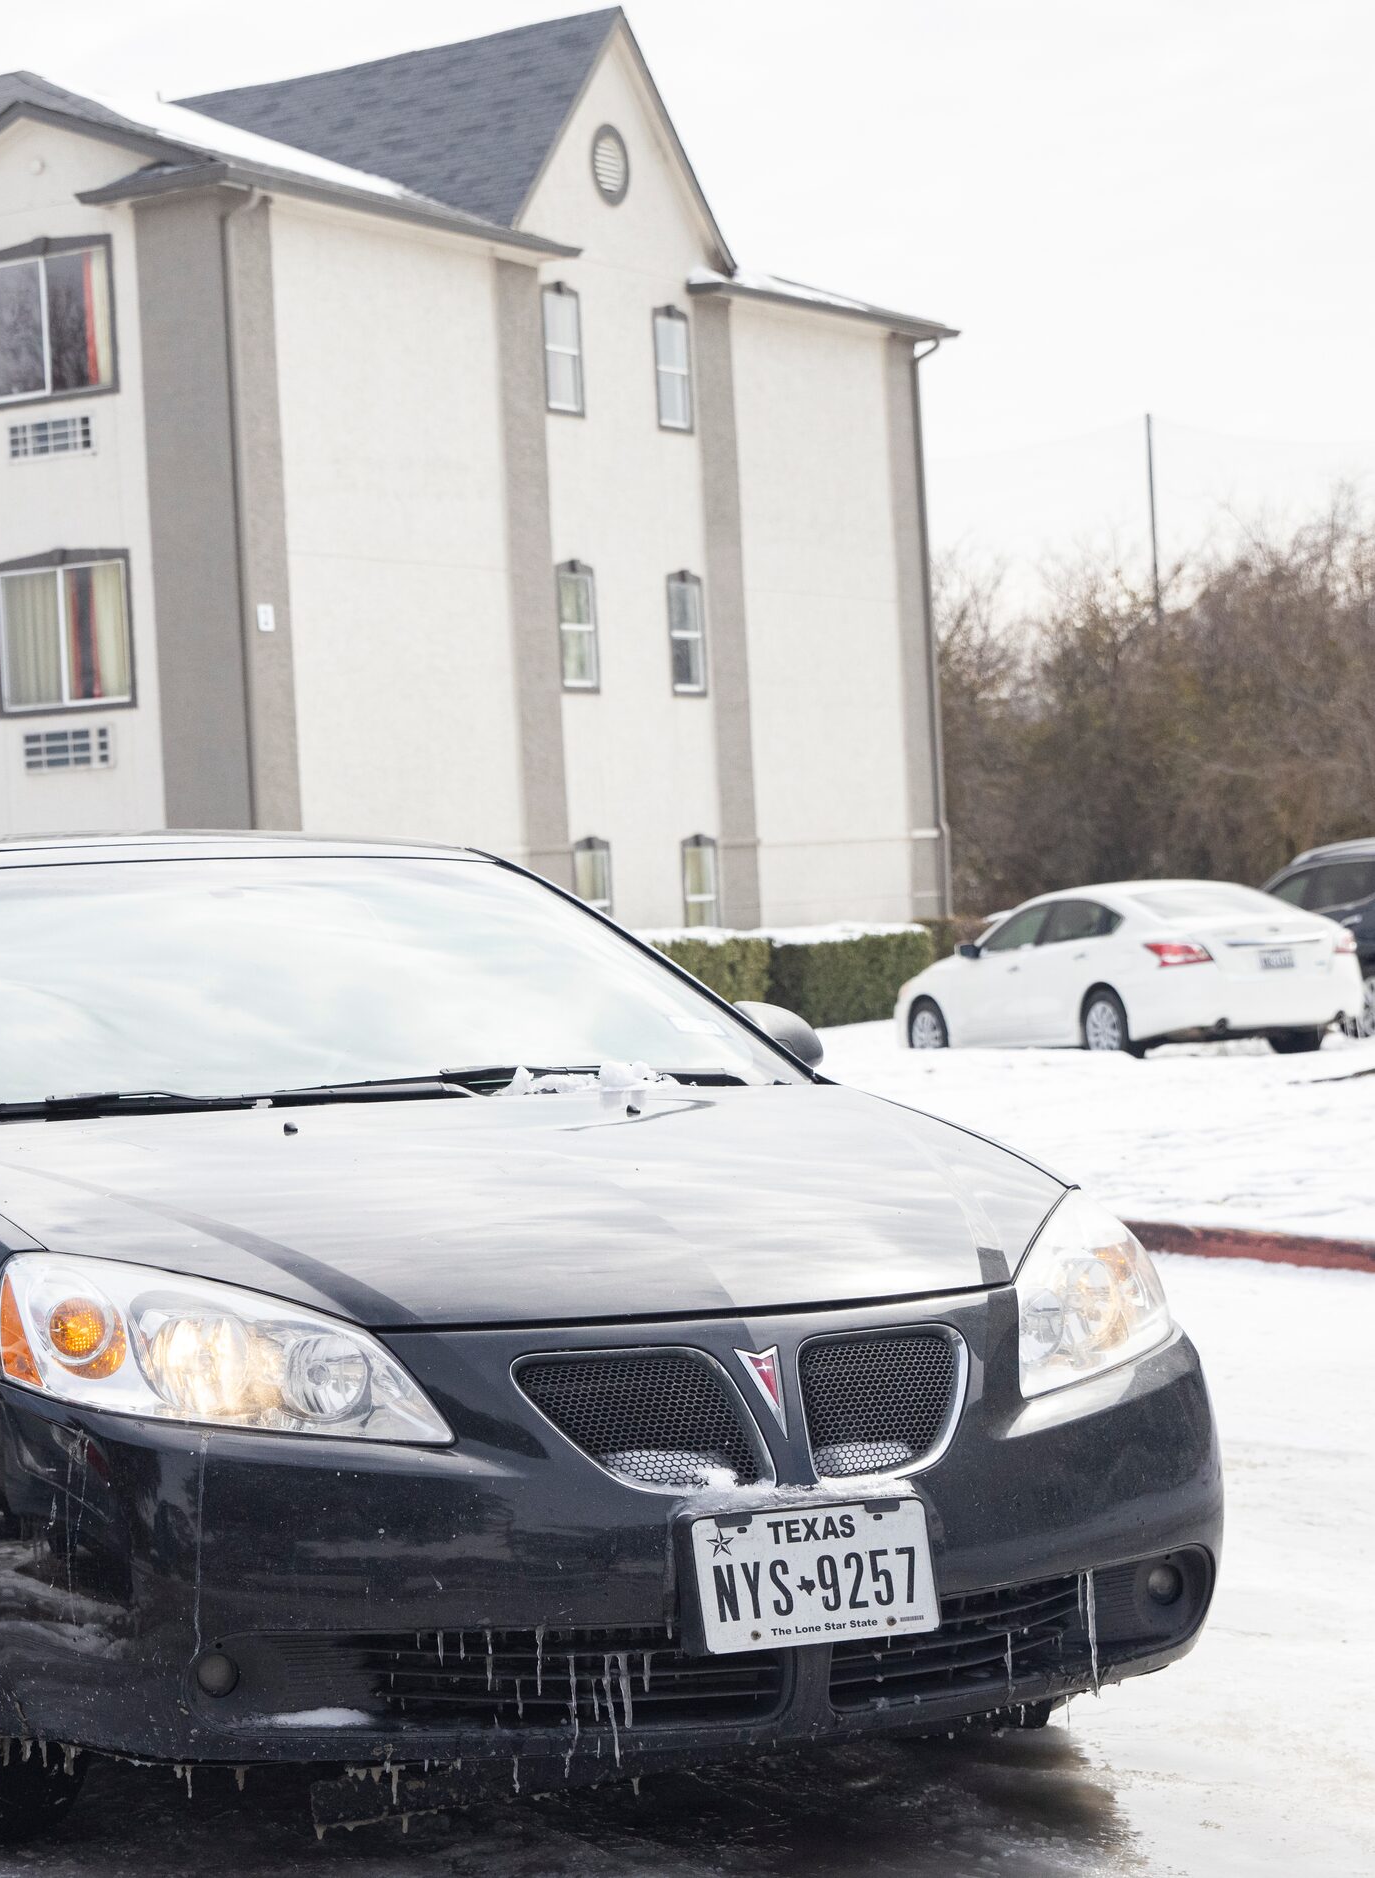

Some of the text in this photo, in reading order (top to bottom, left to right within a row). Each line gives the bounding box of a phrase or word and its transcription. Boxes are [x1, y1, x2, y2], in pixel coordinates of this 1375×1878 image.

[767, 1514, 856, 1545] TEXAS
[712, 1546, 915, 1623] NYS 9257
[770, 1618, 878, 1636] The Lone Star State
